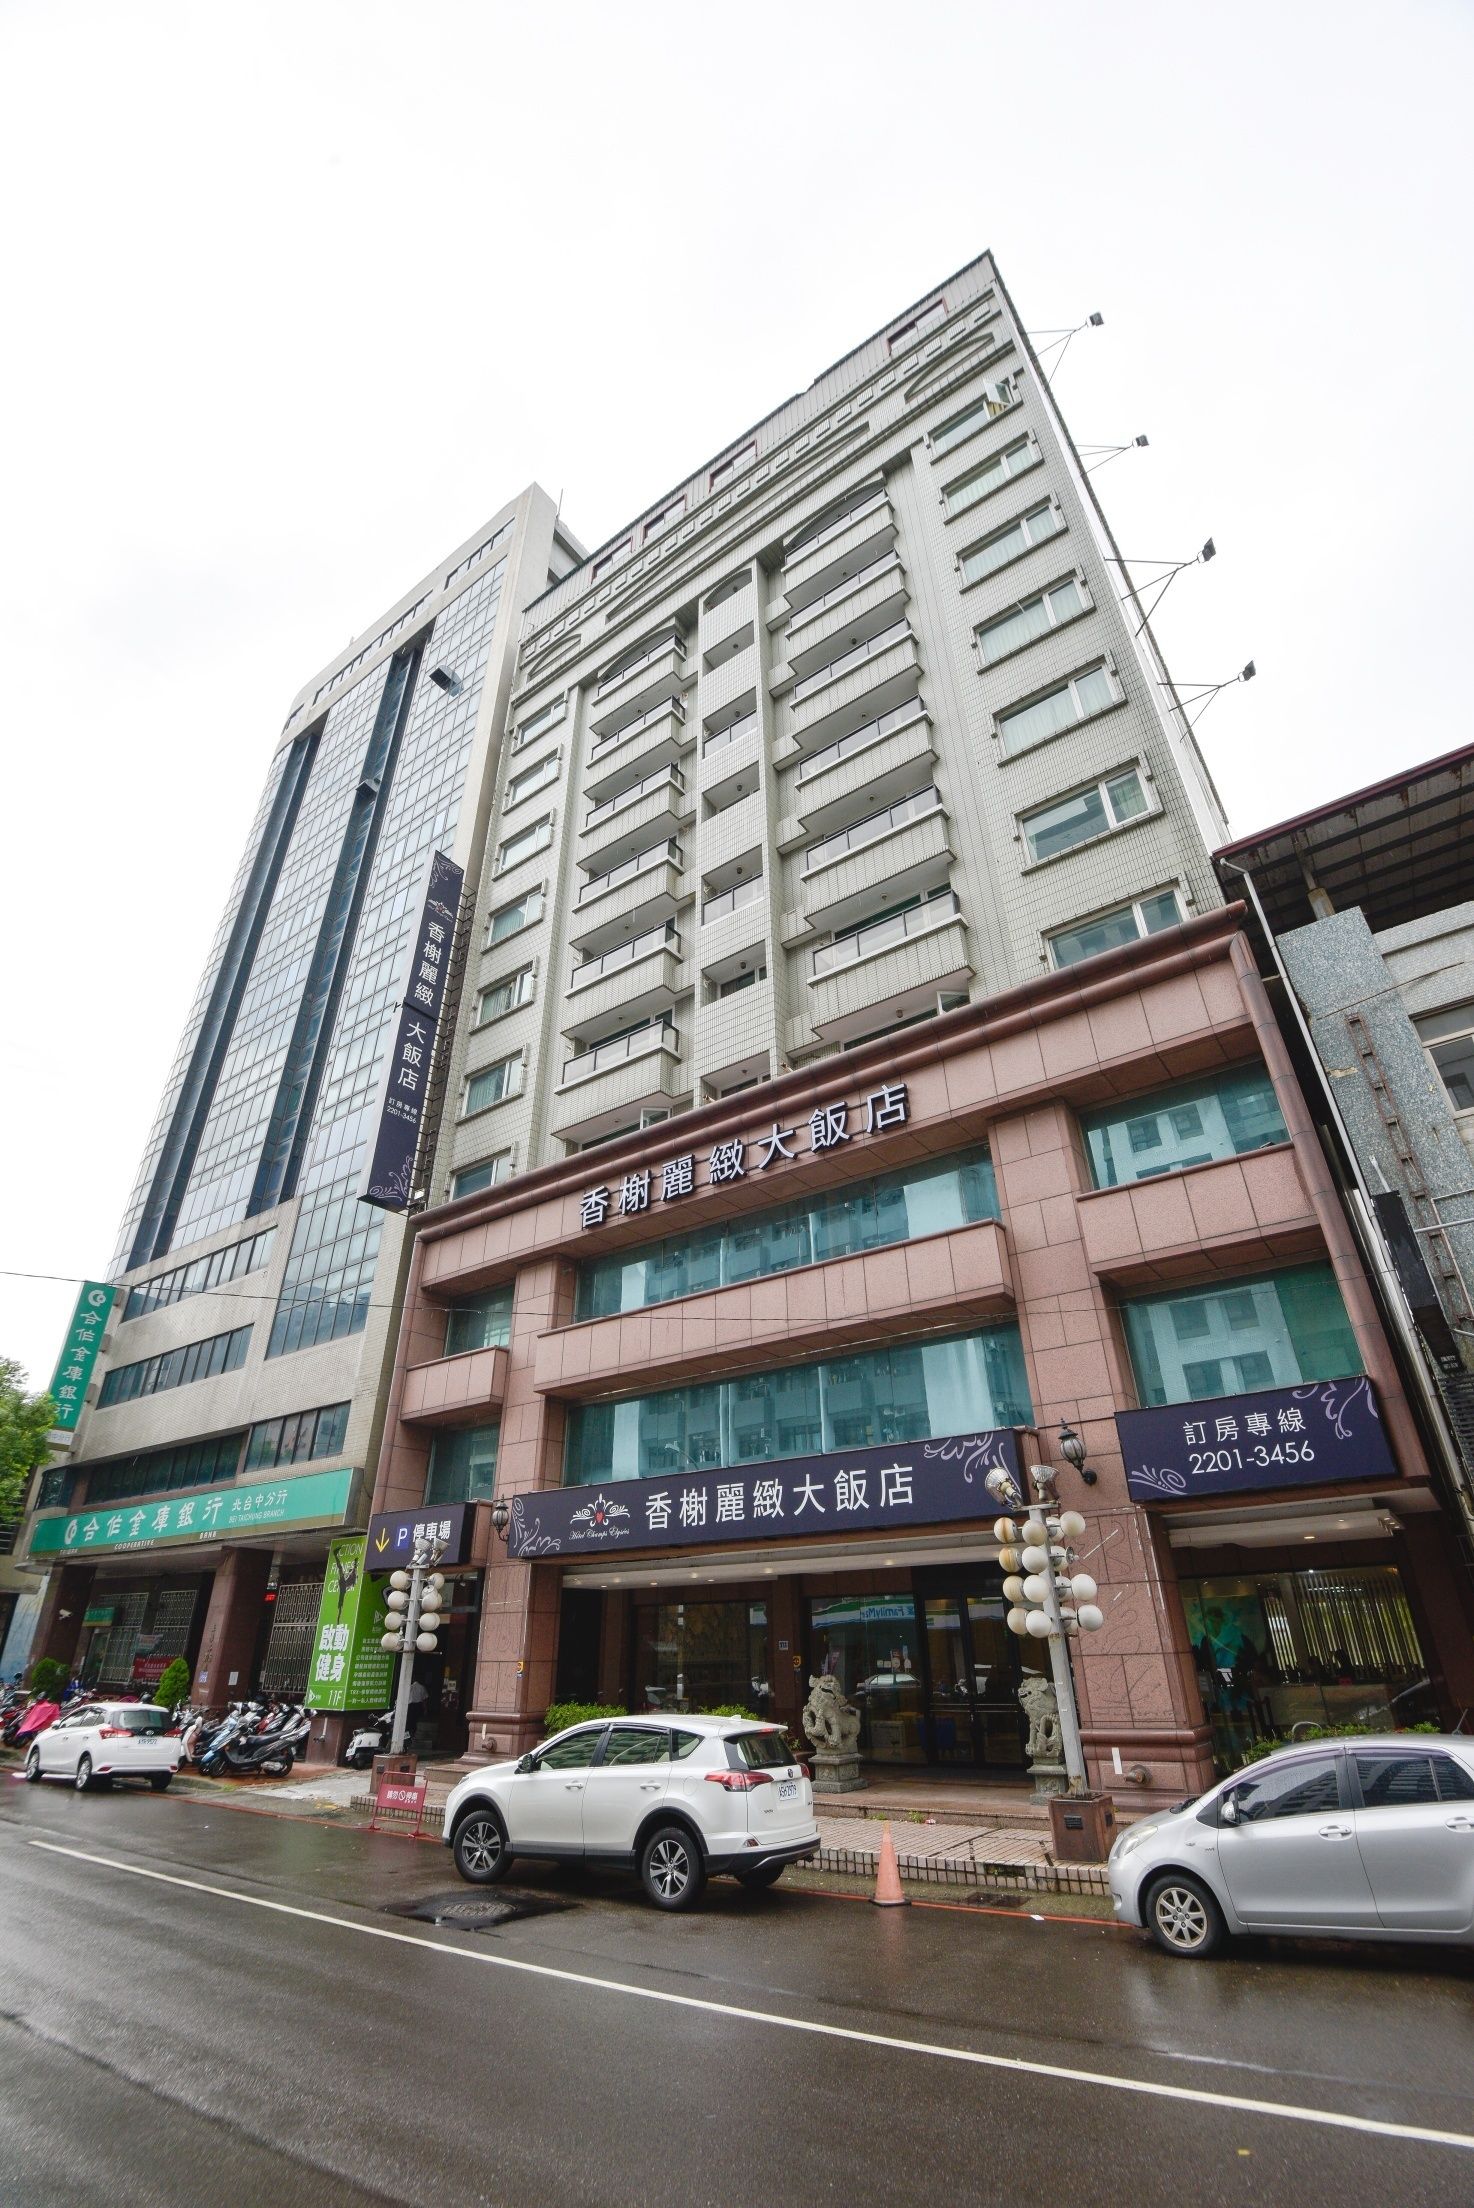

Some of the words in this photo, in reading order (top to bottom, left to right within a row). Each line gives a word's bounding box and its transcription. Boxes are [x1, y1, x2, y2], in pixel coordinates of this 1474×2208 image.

[397, 920, 446, 1091] 香榭麗緻大飯店
[386, 1105, 417, 1124] 2201-3456
[579, 1083, 909, 1230] 香榭麗緻大飯店
[55, 1310, 103, 1420] 合作金庫銀行
[1183, 1407, 1306, 1445] 訂房專線
[1189, 1439, 1316, 1475] 2201-3456
[231, 1489, 289, 1512] 北台中分行
[644, 1462, 915, 1531] 香榭麗緻大飯店
[83, 1497, 224, 1542] 合作金庫銀行
[397, 1527, 408, 1547] P
[412, 1520, 452, 1543] 停車場
[315, 1653, 346, 1682] 健身
